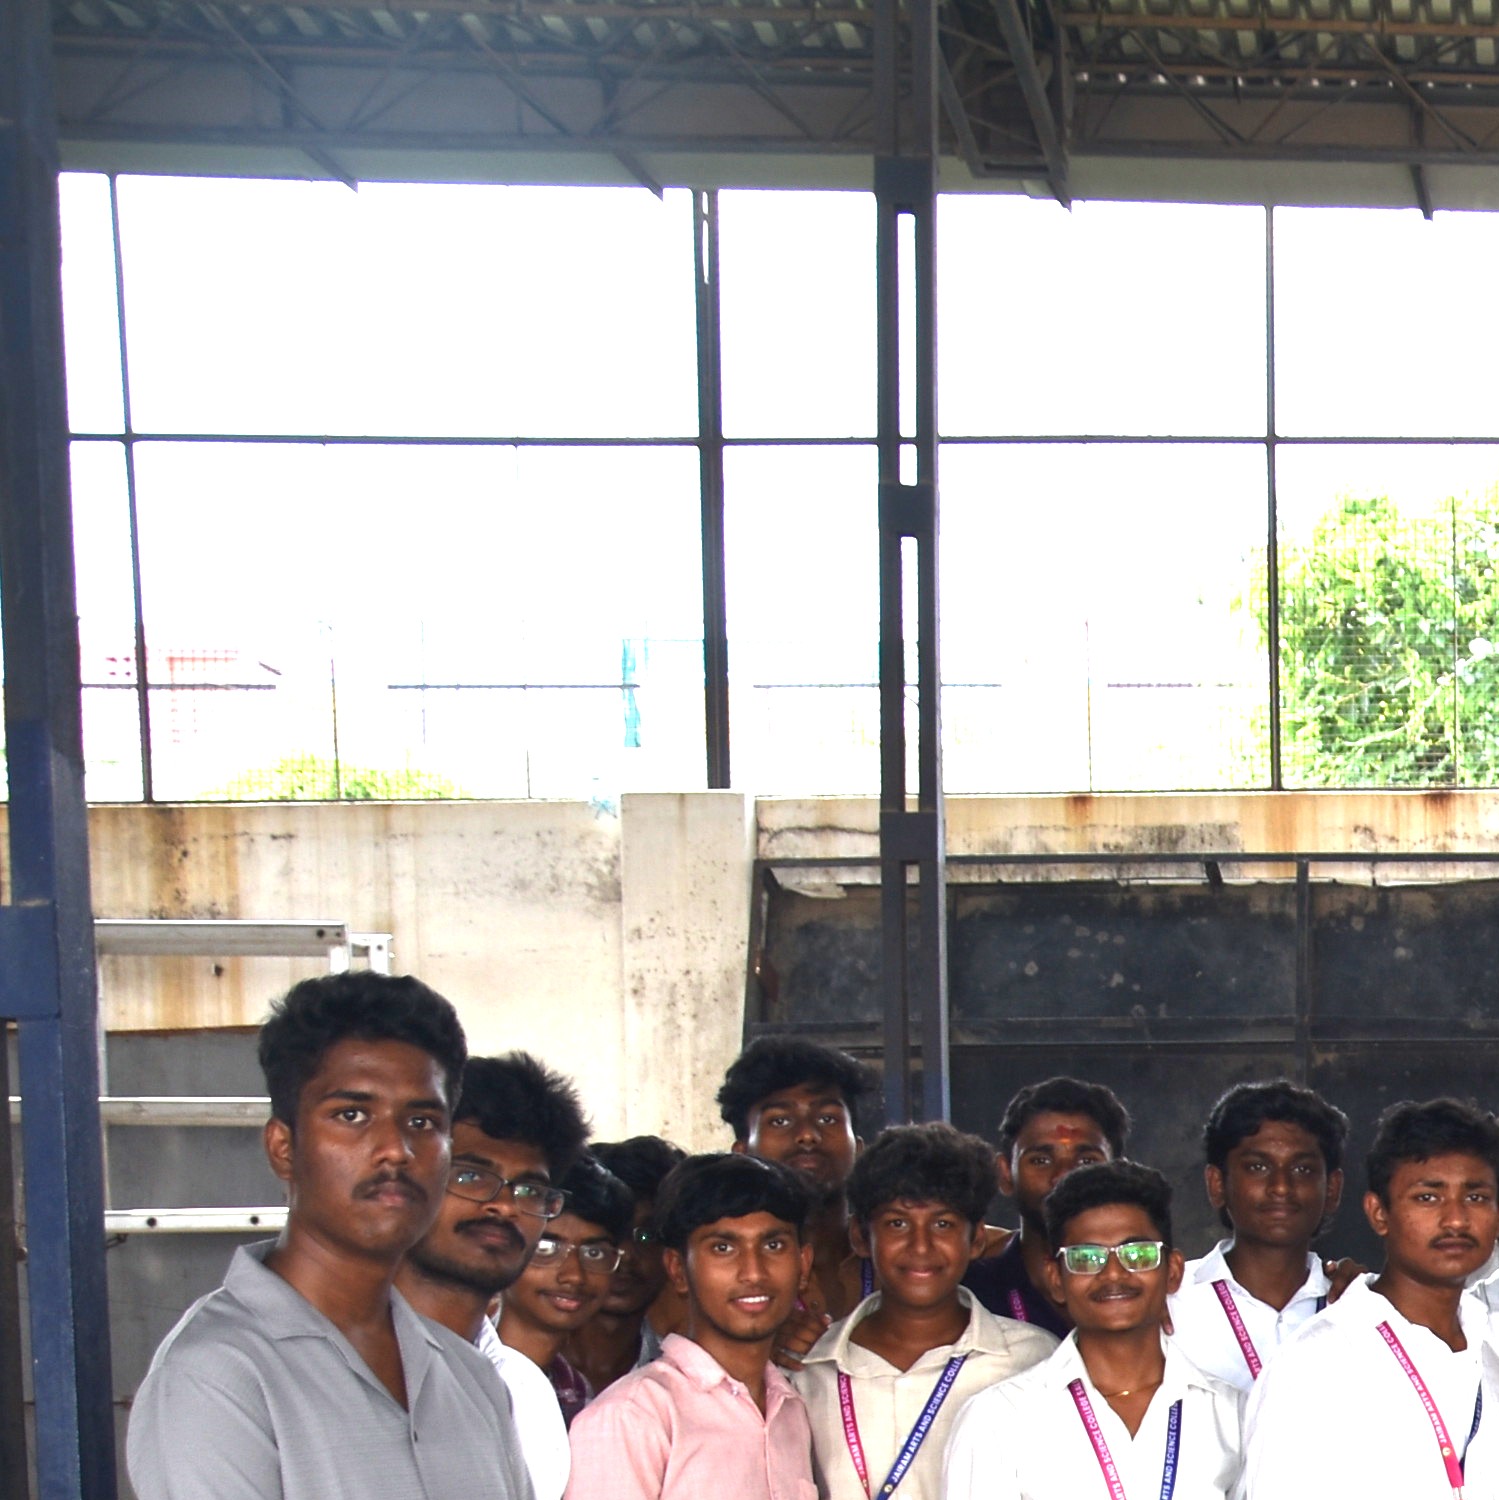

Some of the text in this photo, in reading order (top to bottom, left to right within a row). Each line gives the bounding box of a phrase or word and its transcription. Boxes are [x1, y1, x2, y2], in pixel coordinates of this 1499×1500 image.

[1230, 1311, 1248, 1341] SCIENCE
[1243, 1341, 1256, 1358] AND
[1391, 1343, 1414, 1374] SCIENCE
[1250, 1358, 1262, 1374] RTS
[840, 1373, 850, 1405] SCIENC
[1410, 1374, 1424, 1391] AND
[843, 1405, 852, 1422] AND
[1079, 1397, 1098, 1429] COLLEGE
[1420, 1391, 1434, 1412] ARTS
[892, 1355, 963, 1482] JAIRAM ARTS AND SCIENCE COLLE
[1169, 1403, 1178, 1430] COLLE
[1430, 1412, 1447, 1443] JAIRAM
[846, 1423, 857, 1443] ARTS
[1093, 1430, 1112, 1463] SCIENCE
[1166, 1431, 1176, 1464] SCIENCE
[1106, 1464, 1118, 1481] AND
[1164, 1465, 1173, 1484] AND
